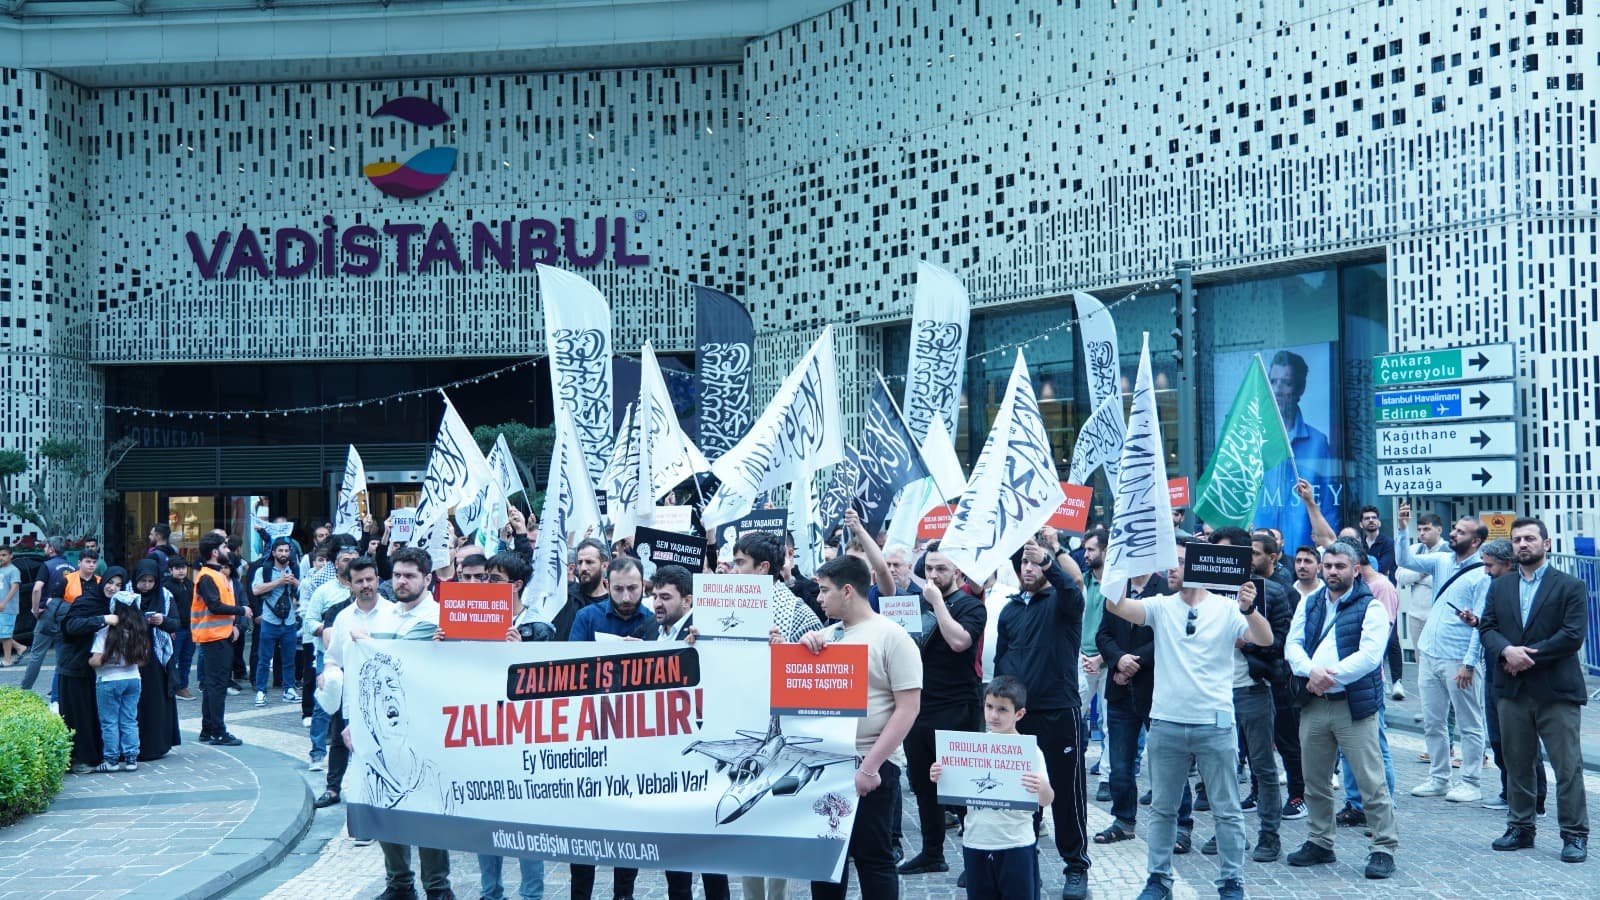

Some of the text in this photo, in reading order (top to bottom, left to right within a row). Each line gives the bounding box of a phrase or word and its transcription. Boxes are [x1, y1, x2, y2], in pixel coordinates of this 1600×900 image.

[1381, 355, 1431, 369] Ankara
[1381, 364, 1455, 383] Çevreyolu
[1382, 395, 1413, 405] İstanbul
[1382, 408, 1427, 420] Edirne
[1383, 429, 1457, 443] Kağıthane
[1384, 443, 1432, 455] Hasdal
[1384, 464, 1432, 476] Maslak
[1384, 479, 1442, 492] Ayazağa
[1262, 484, 1343, 507] MSEY
[741, 518, 783, 529] SEN YAŞARKEN
[656, 540, 702, 555] SEN YAŞARKEN
[735, 584, 762, 594] AKSAYA
[444, 599, 510, 610] SOCAR PETROL DEĞİL
[738, 599, 769, 609] GAZZEYE
[449, 611, 468, 622] ÖLÜM
[469, 612, 501, 624] YOLLUYOR
[515, 655, 689, 695] ZALİMLE İŞ TUTAN,
[785, 663, 813, 674] SOCAR
[815, 663, 849, 675] SATIYOR
[786, 678, 813, 691] BOTAŞ
[814, 678, 848, 691] TAŞIYOR
[442, 687, 704, 748] ZALİMLE ANILIR!
[949, 741, 1023, 756] ORDULAR AKSAYA
[522, 745, 608, 775] Ey Yöneticiler!
[994, 759, 1032, 771] GAZZEYE
[452, 769, 709, 804] Ey SOCAR! Bu Ticaretin Kârı Yok, Vebali Var!
[492, 829, 660, 862] KÖKLÜ DEĞİŞİM GENÇLİK KOLARI
